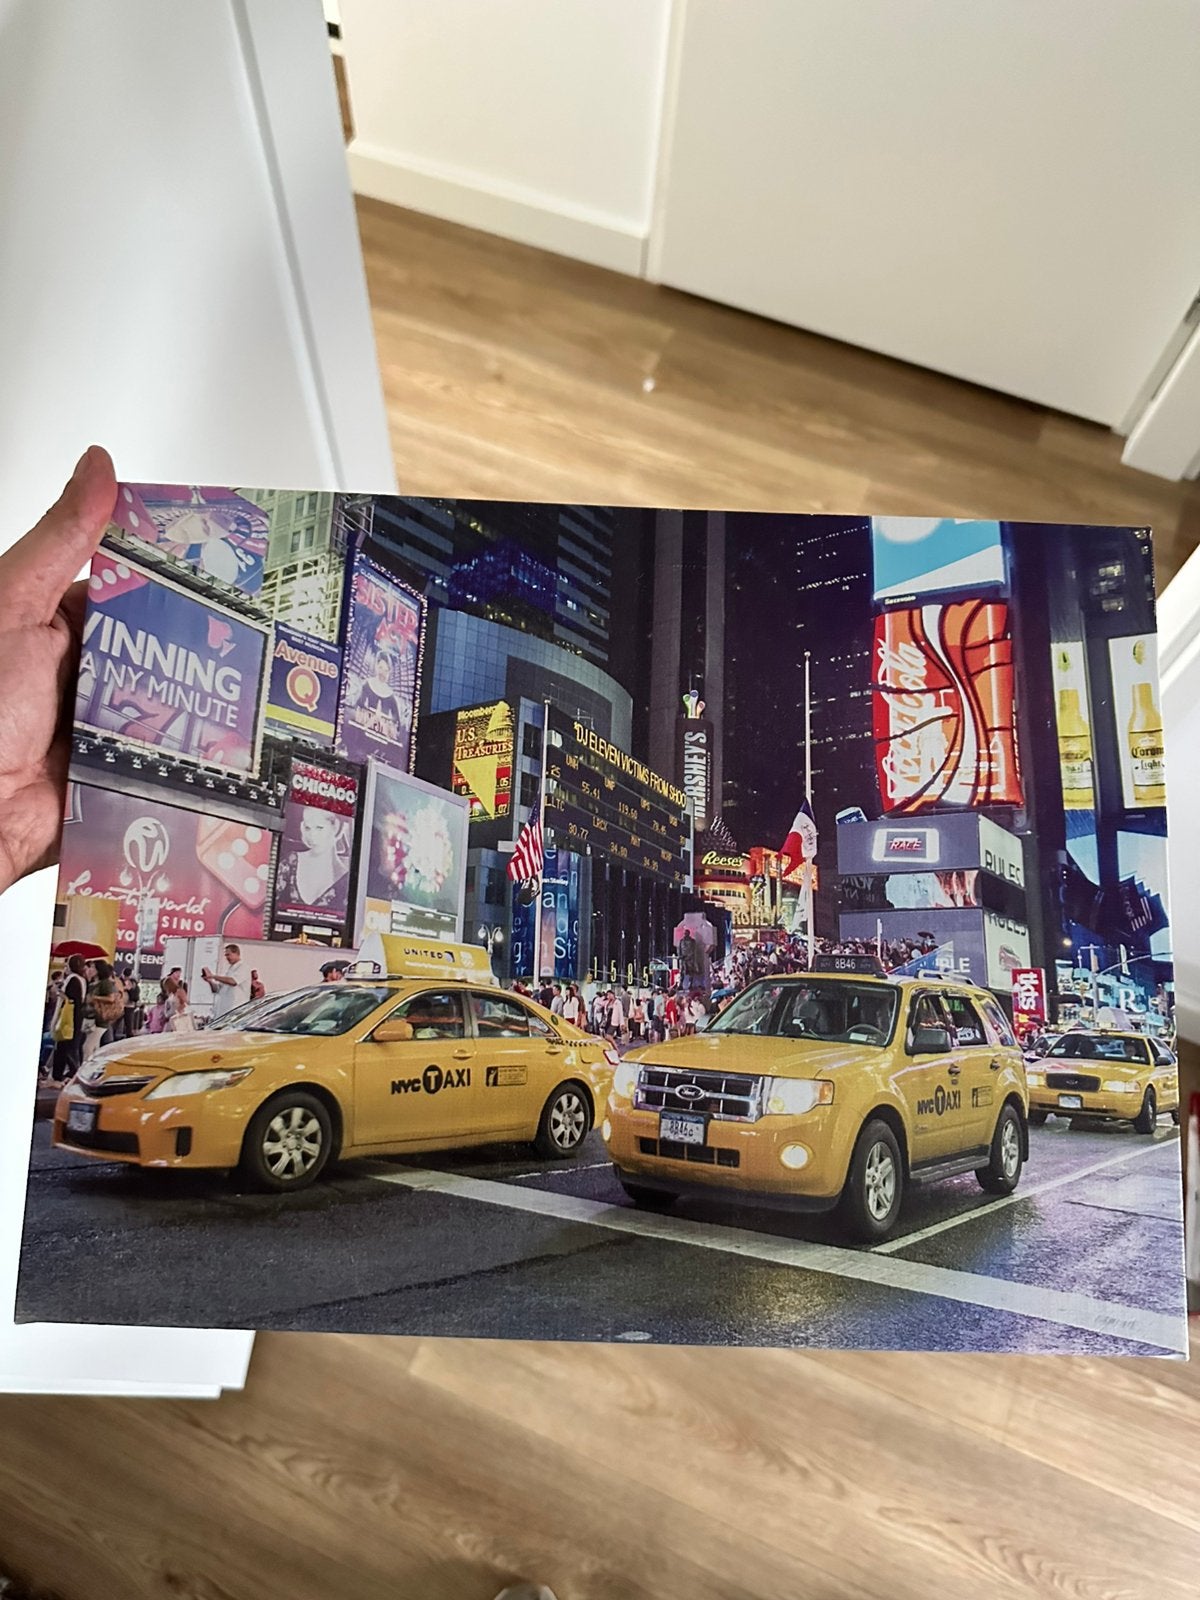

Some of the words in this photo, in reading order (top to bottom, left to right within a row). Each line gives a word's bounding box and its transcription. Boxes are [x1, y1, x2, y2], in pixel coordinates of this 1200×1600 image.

[357, 576, 418, 631] SISTER
[82, 611, 242, 701] INNING
[274, 639, 339, 679] Avenue
[147, 674, 239, 728] MINUTE
[286, 665, 321, 713] Q
[456, 726, 478, 743] U.S.
[589, 732, 621, 767] ELEVEN
[620, 752, 650, 784] VICTIMS
[649, 771, 669, 798] FROM
[292, 773, 356, 804] CHICAGO
[702, 851, 743, 867] Reese's
[125, 952, 164, 965] QEENS
[403, 948, 444, 959] UNITED
[1017, 972, 1039, 1011] tkts
[391, 1079, 421, 1095] NYC
[424, 1065, 471, 1092] TAXI
[917, 1099, 935, 1115] NYC
[936, 1088, 961, 1114] TAXI
